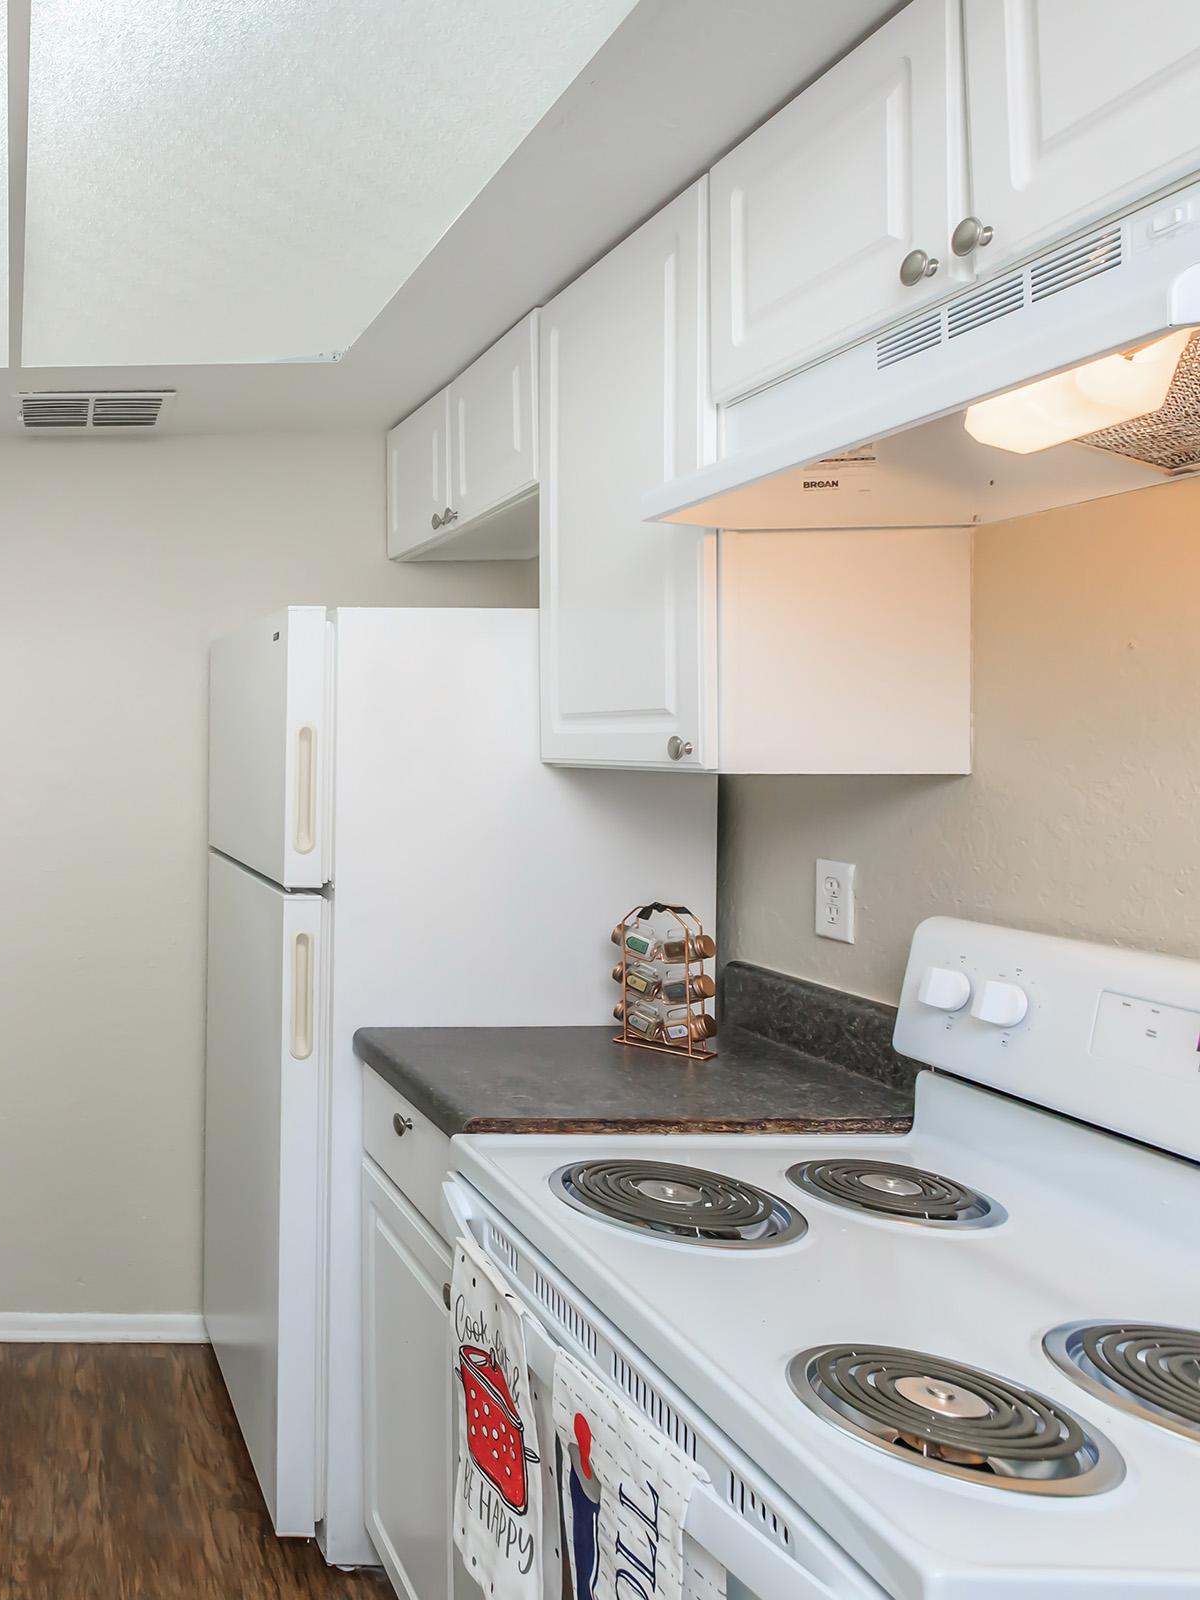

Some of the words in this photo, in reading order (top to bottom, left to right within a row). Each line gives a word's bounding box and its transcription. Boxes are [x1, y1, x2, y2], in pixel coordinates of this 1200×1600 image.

[803, 480, 839, 489] BROAN
[463, 1457, 475, 1511] BE
[478, 1480, 534, 1575] HAPPY
